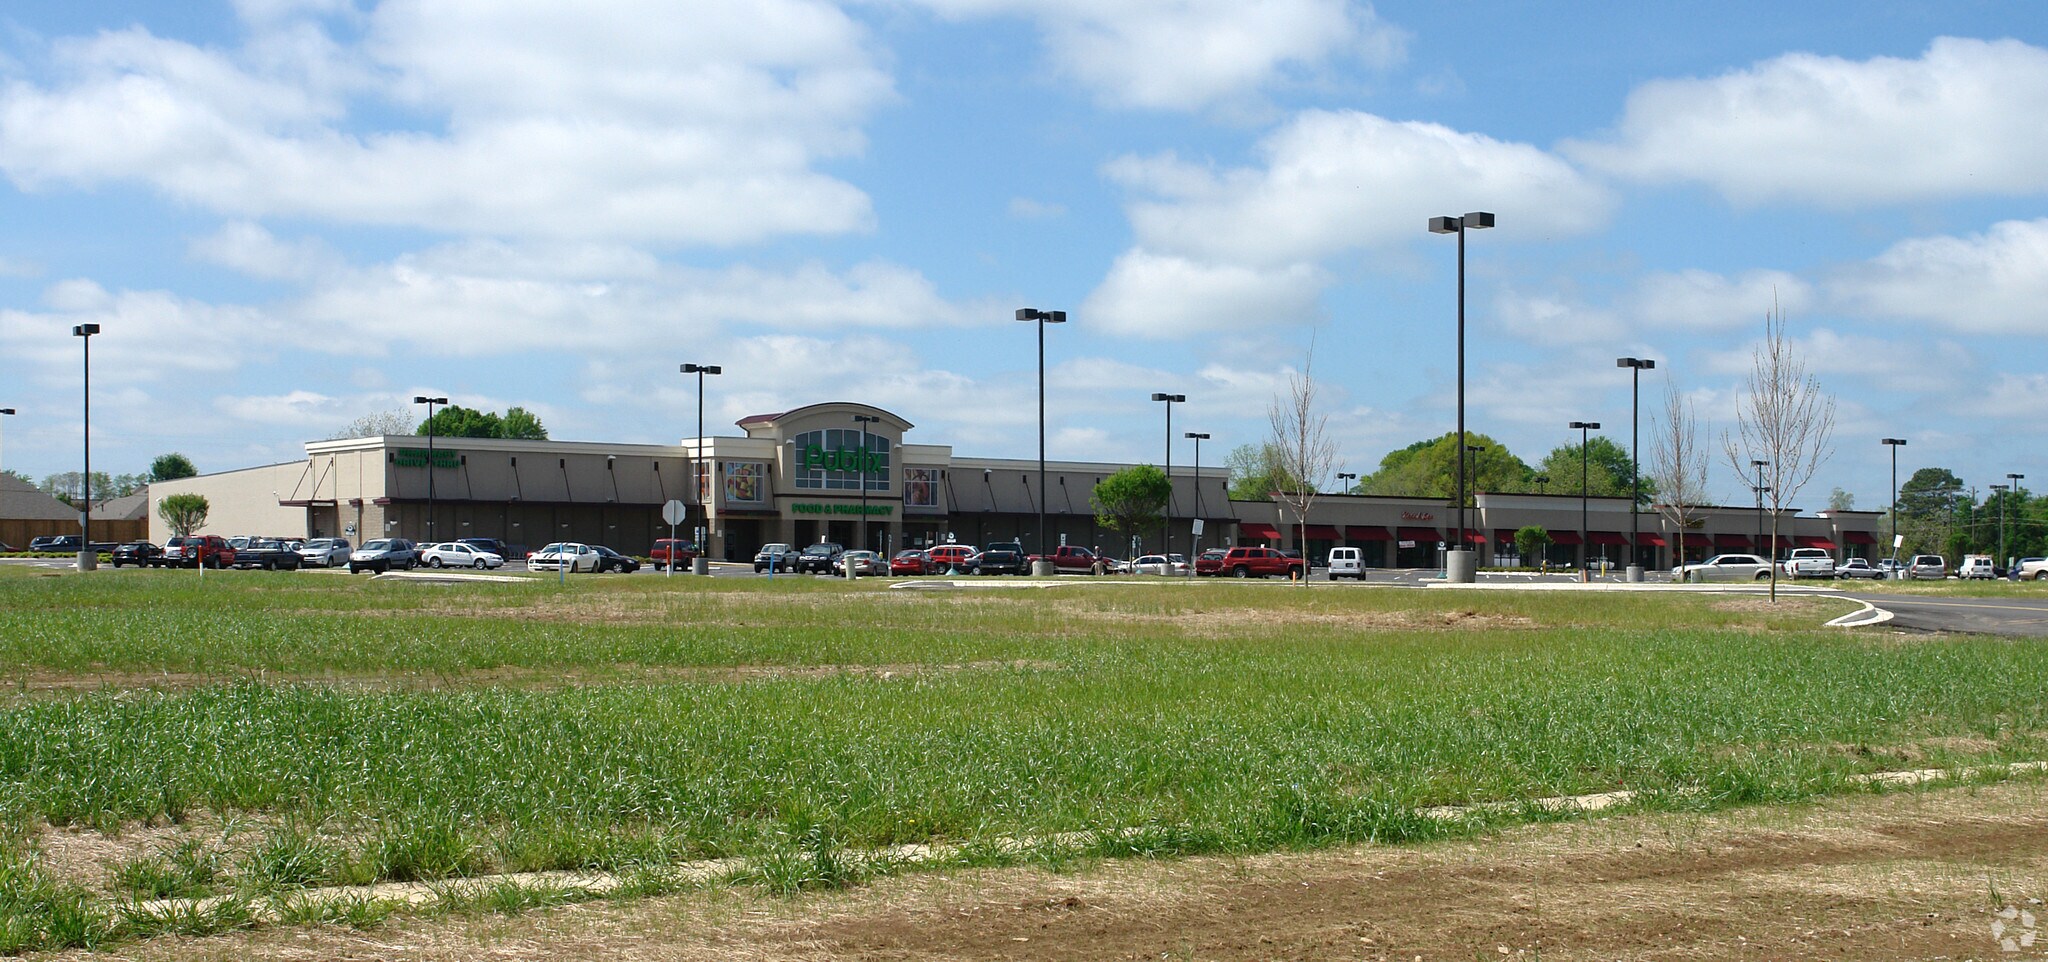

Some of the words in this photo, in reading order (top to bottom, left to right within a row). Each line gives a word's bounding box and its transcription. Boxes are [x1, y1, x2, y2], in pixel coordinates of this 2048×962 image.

[805, 444, 883, 473] Publix
[792, 503, 822, 514] FOOD
[824, 504, 832, 514] &
[833, 504, 894, 515] PHARMACY
